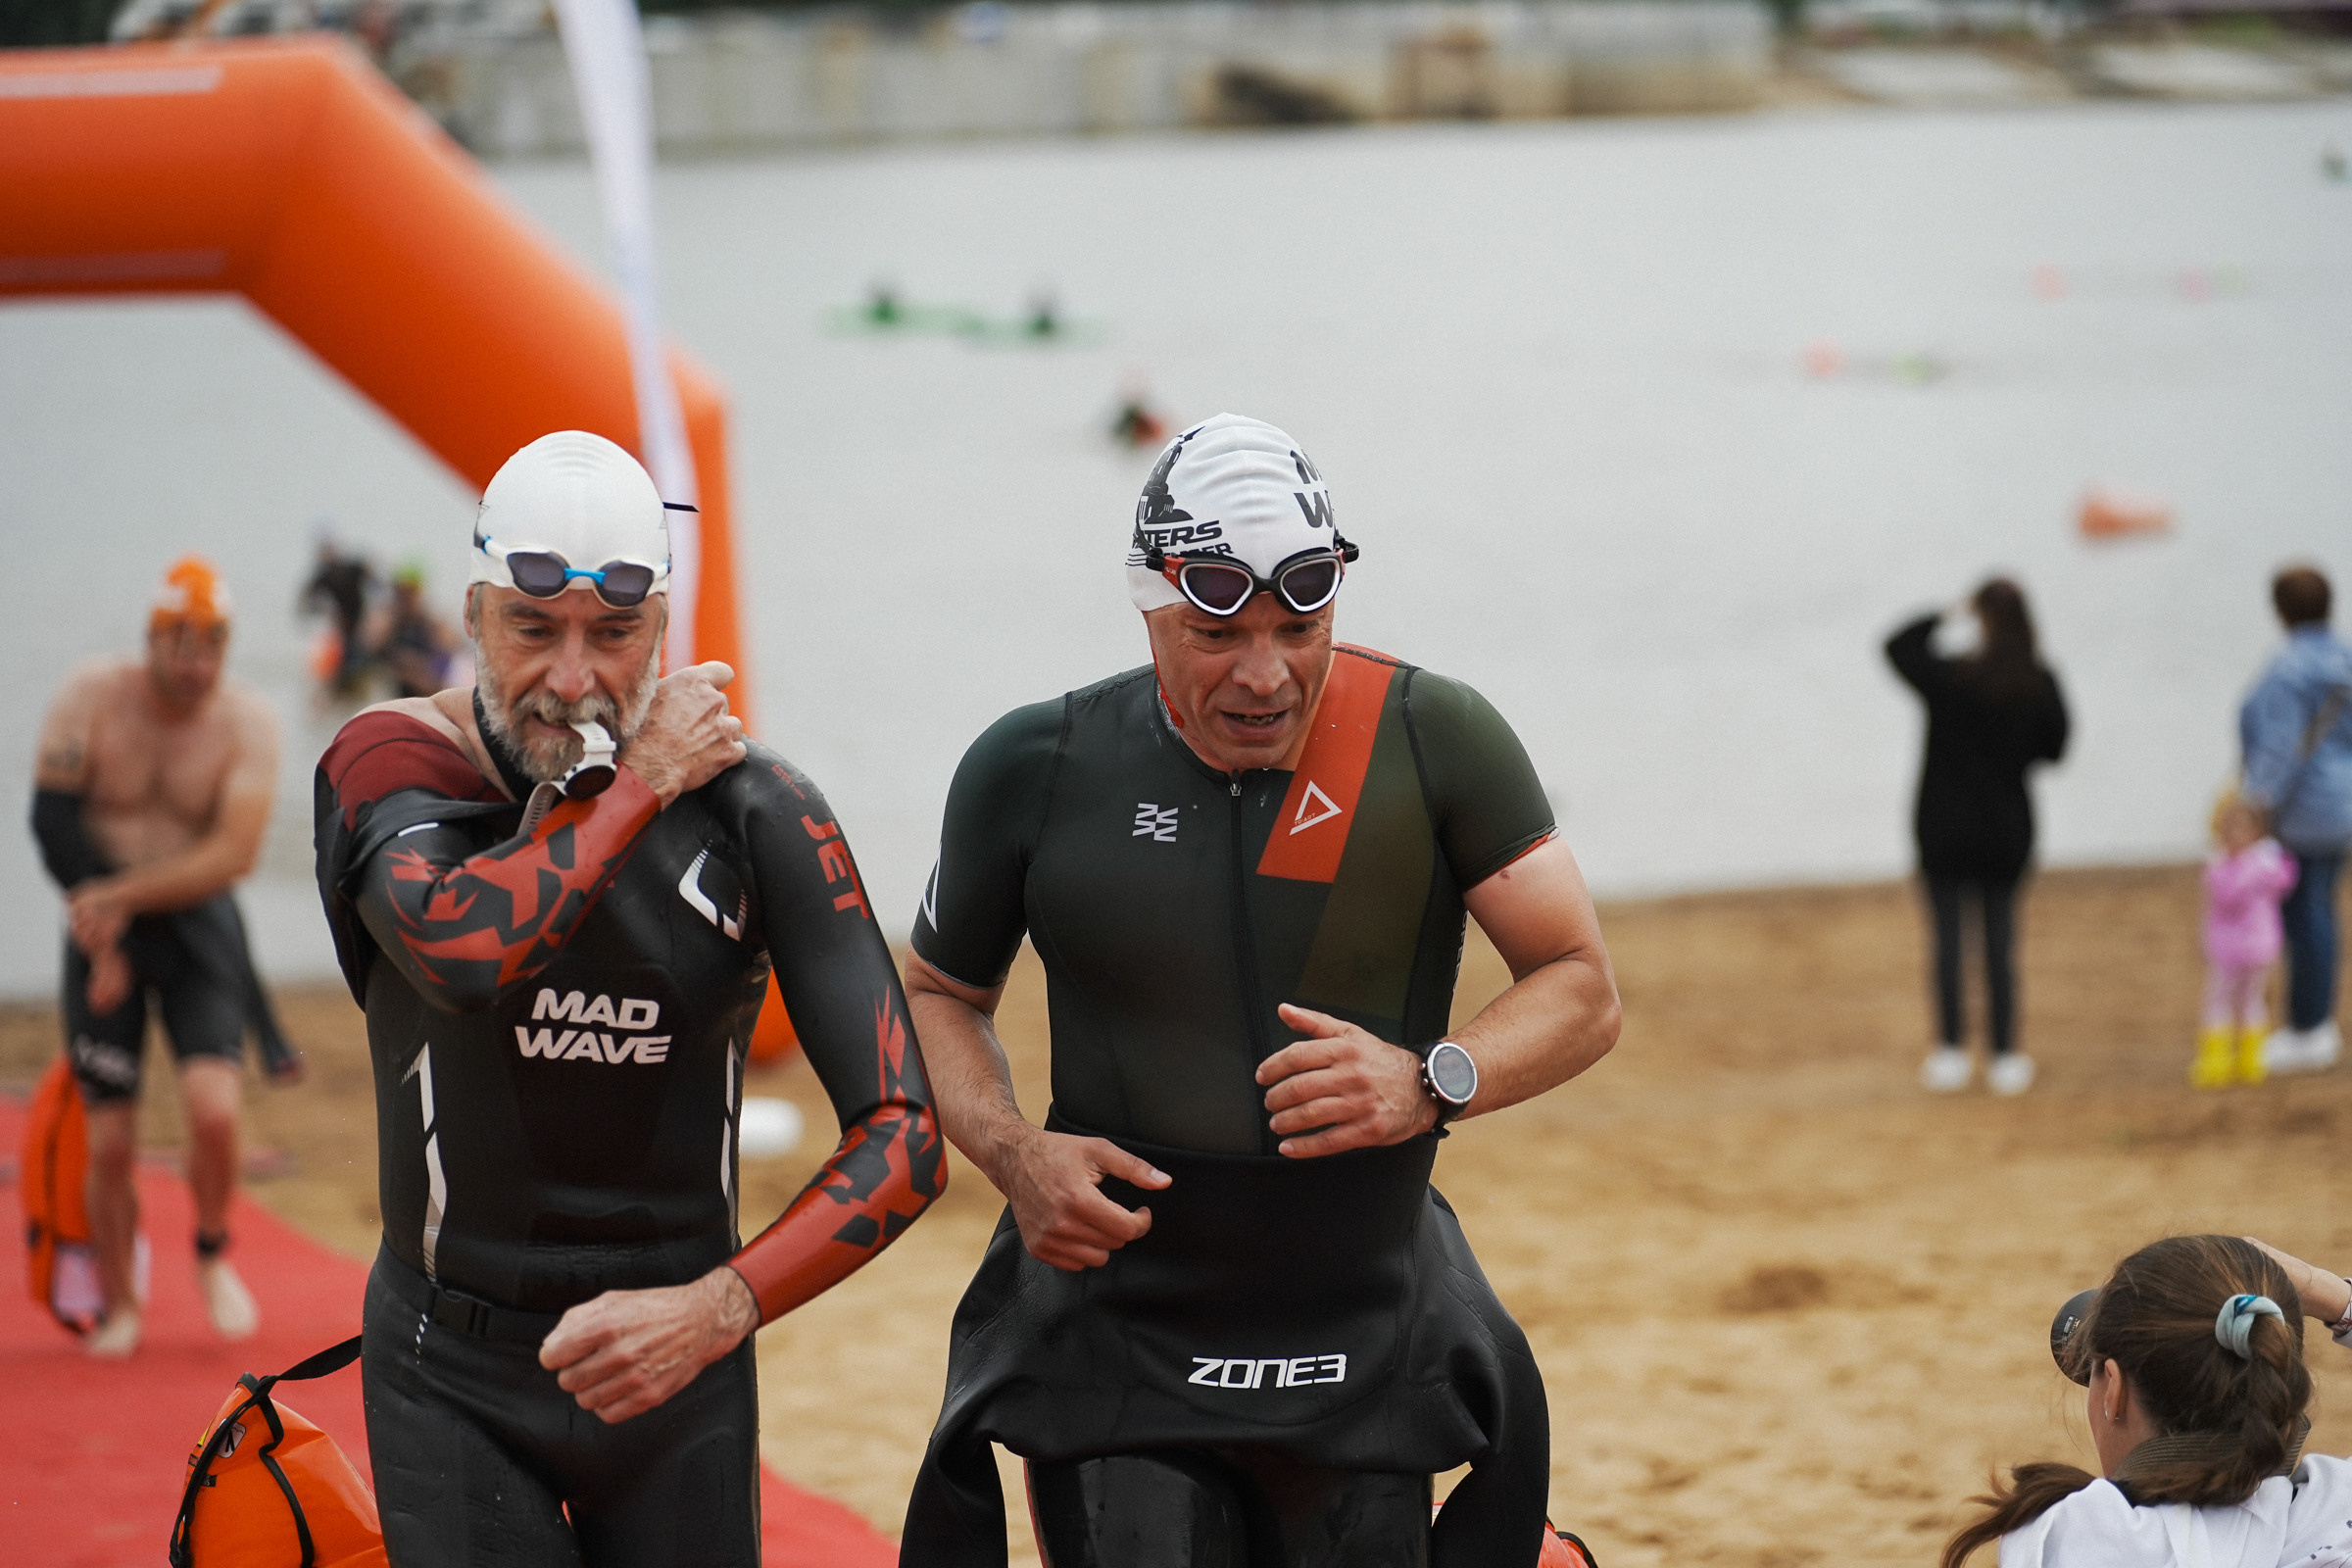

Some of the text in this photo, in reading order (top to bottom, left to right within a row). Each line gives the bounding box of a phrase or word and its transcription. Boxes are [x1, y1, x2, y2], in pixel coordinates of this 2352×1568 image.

[1132, 520, 1222, 549] TERS
[801, 815, 869, 918] JET
[531, 988, 660, 1030] MAD
[514, 1026, 672, 1064] WAVE
[1188, 1353, 1347, 1389] ZONE3
